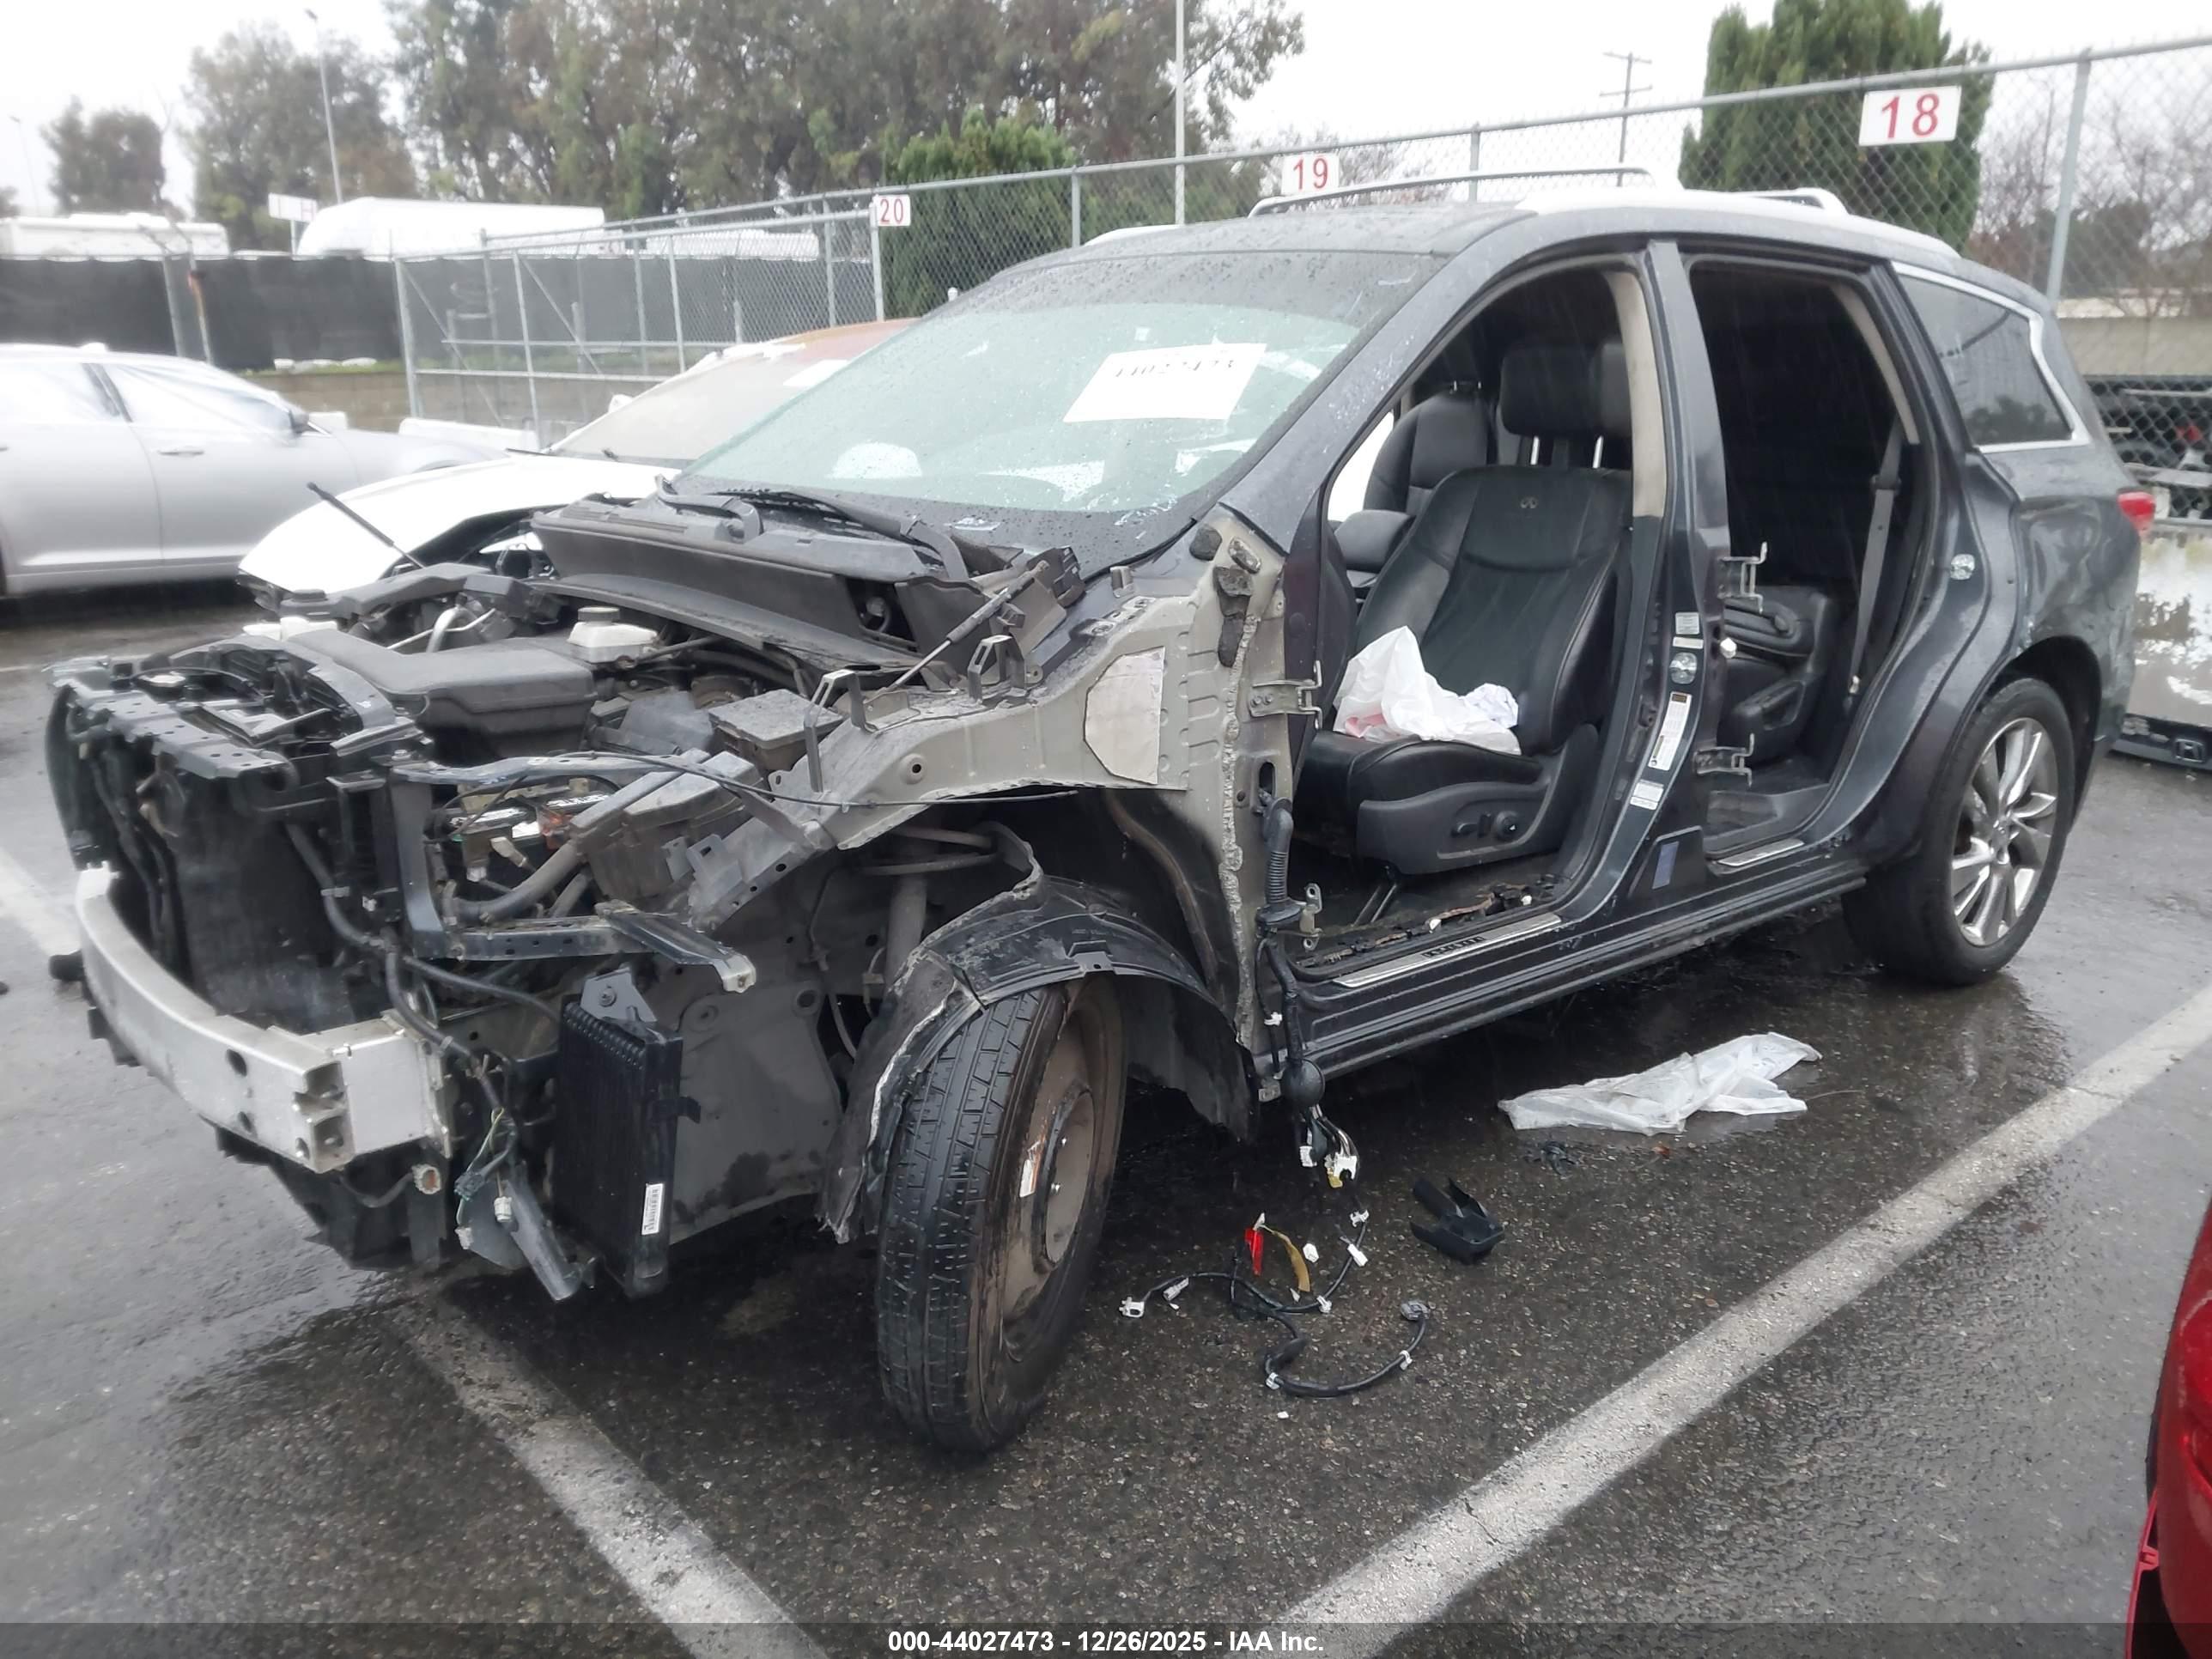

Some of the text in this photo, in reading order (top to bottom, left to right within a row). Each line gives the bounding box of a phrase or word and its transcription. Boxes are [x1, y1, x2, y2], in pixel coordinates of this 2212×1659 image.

[1881, 93, 1940, 139] 18
[1293, 158, 1328, 191] 19
[879, 198, 904, 223] 20
